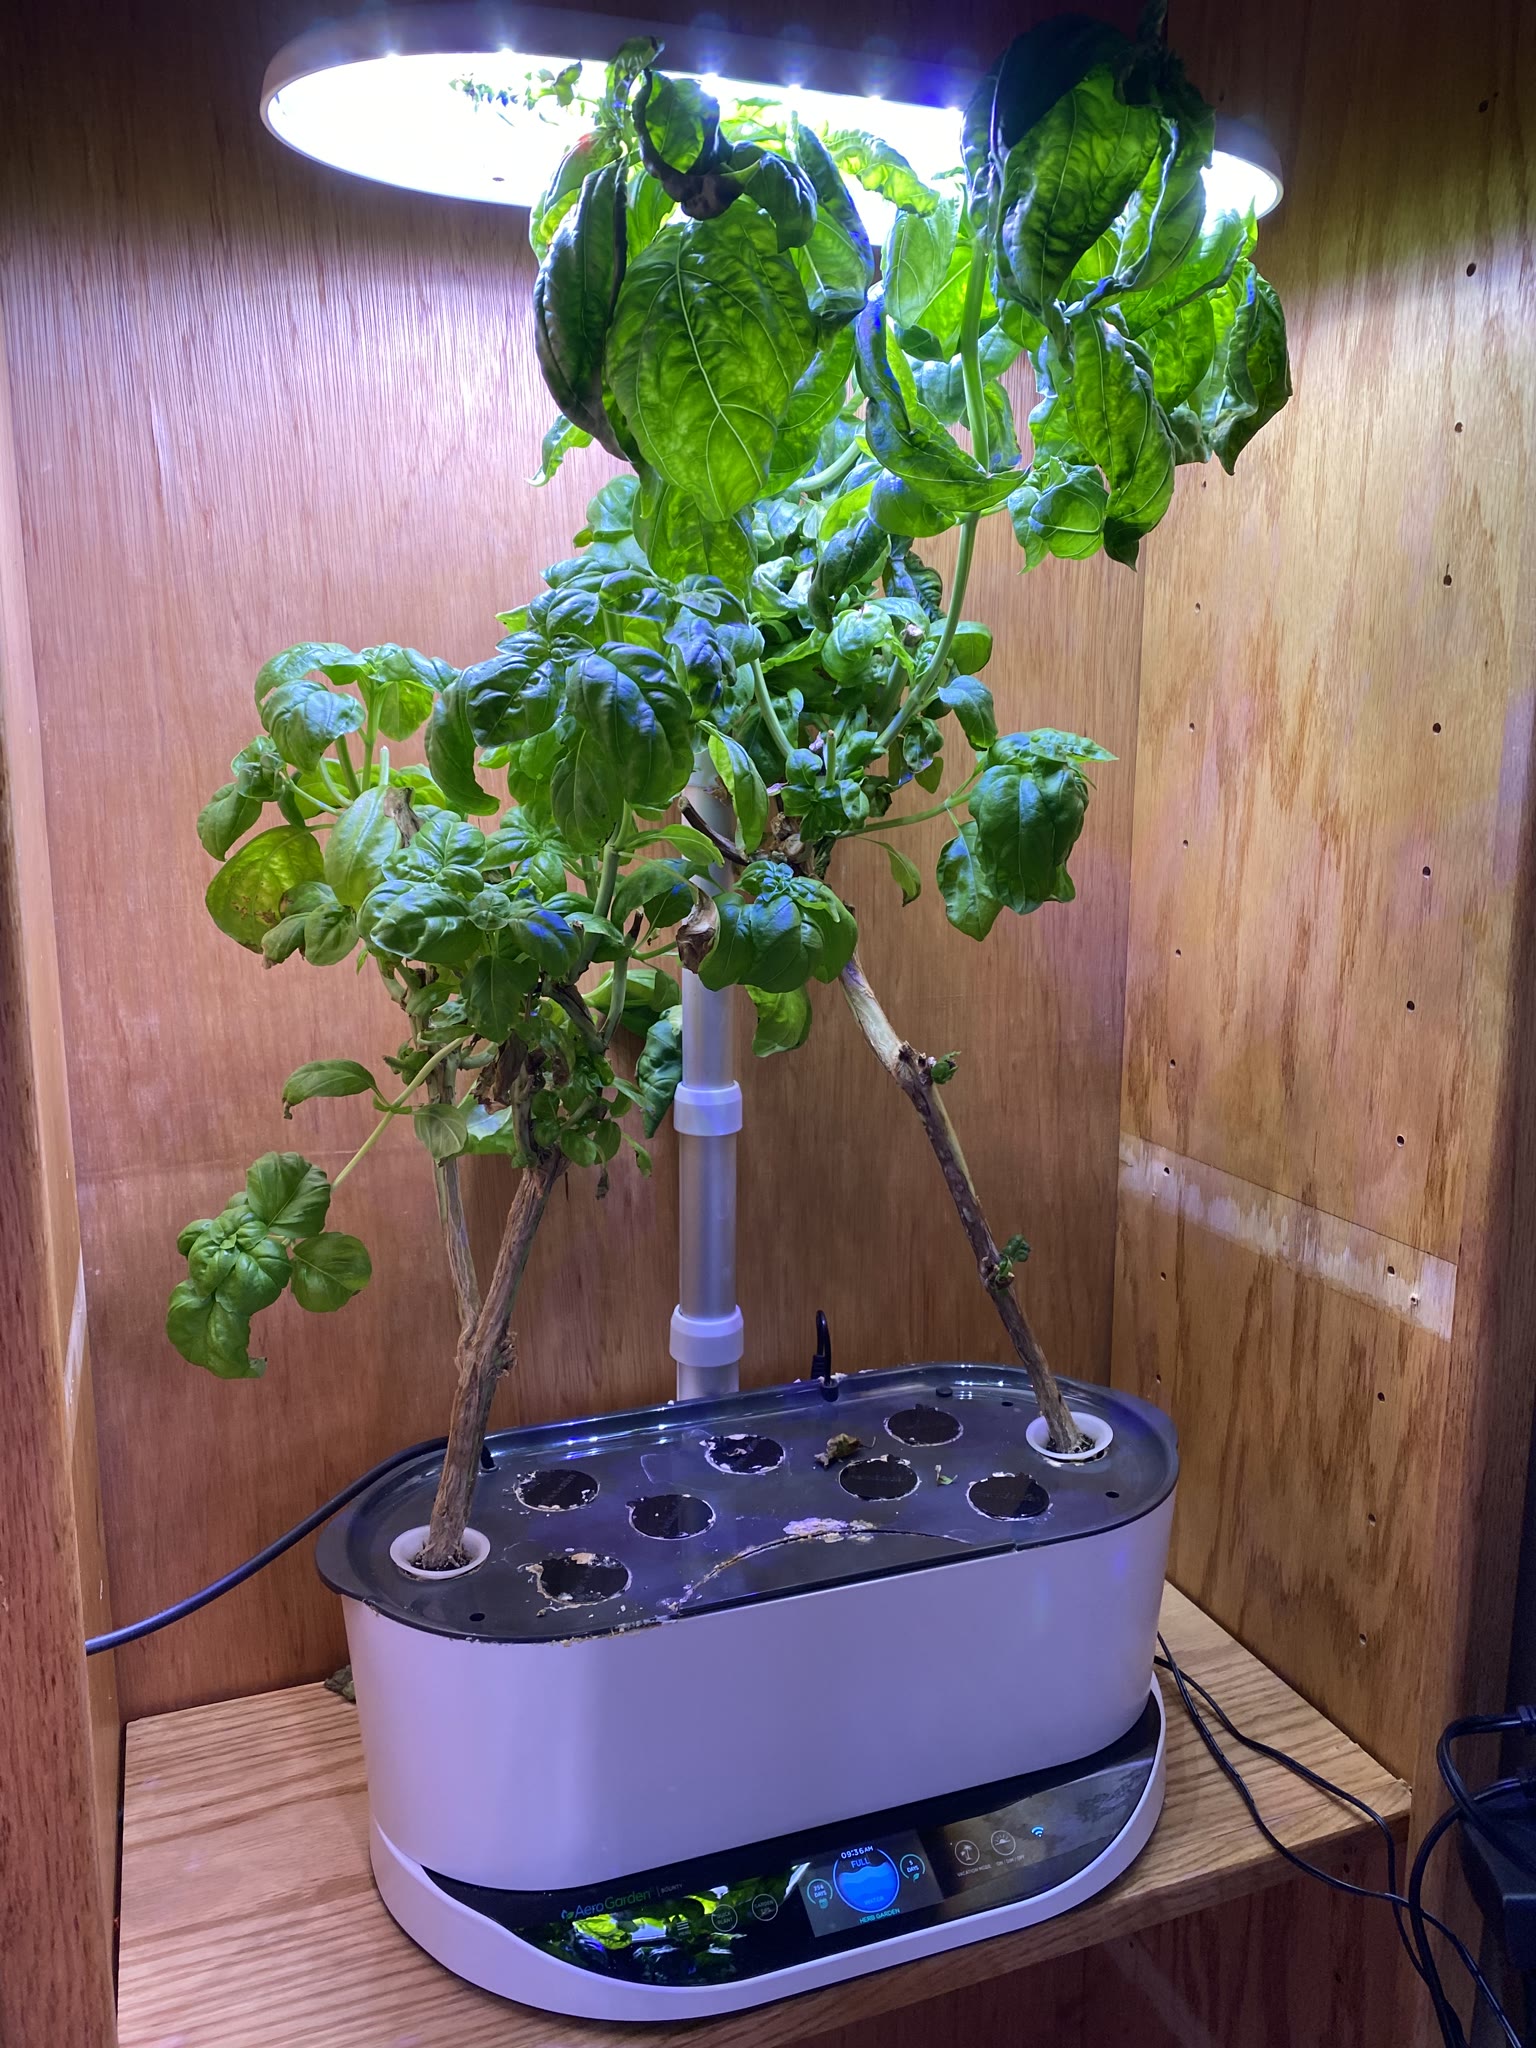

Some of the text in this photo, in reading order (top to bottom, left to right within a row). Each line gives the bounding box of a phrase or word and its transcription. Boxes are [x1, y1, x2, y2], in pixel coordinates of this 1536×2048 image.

[851, 1857, 870, 1868] FULL
[906, 1864, 920, 1873] DAYS
[814, 1890, 827, 1898] DAYS
[574, 1890, 651, 1918] AeroGarden
[859, 1908, 901, 1924] HERB GARDEN
